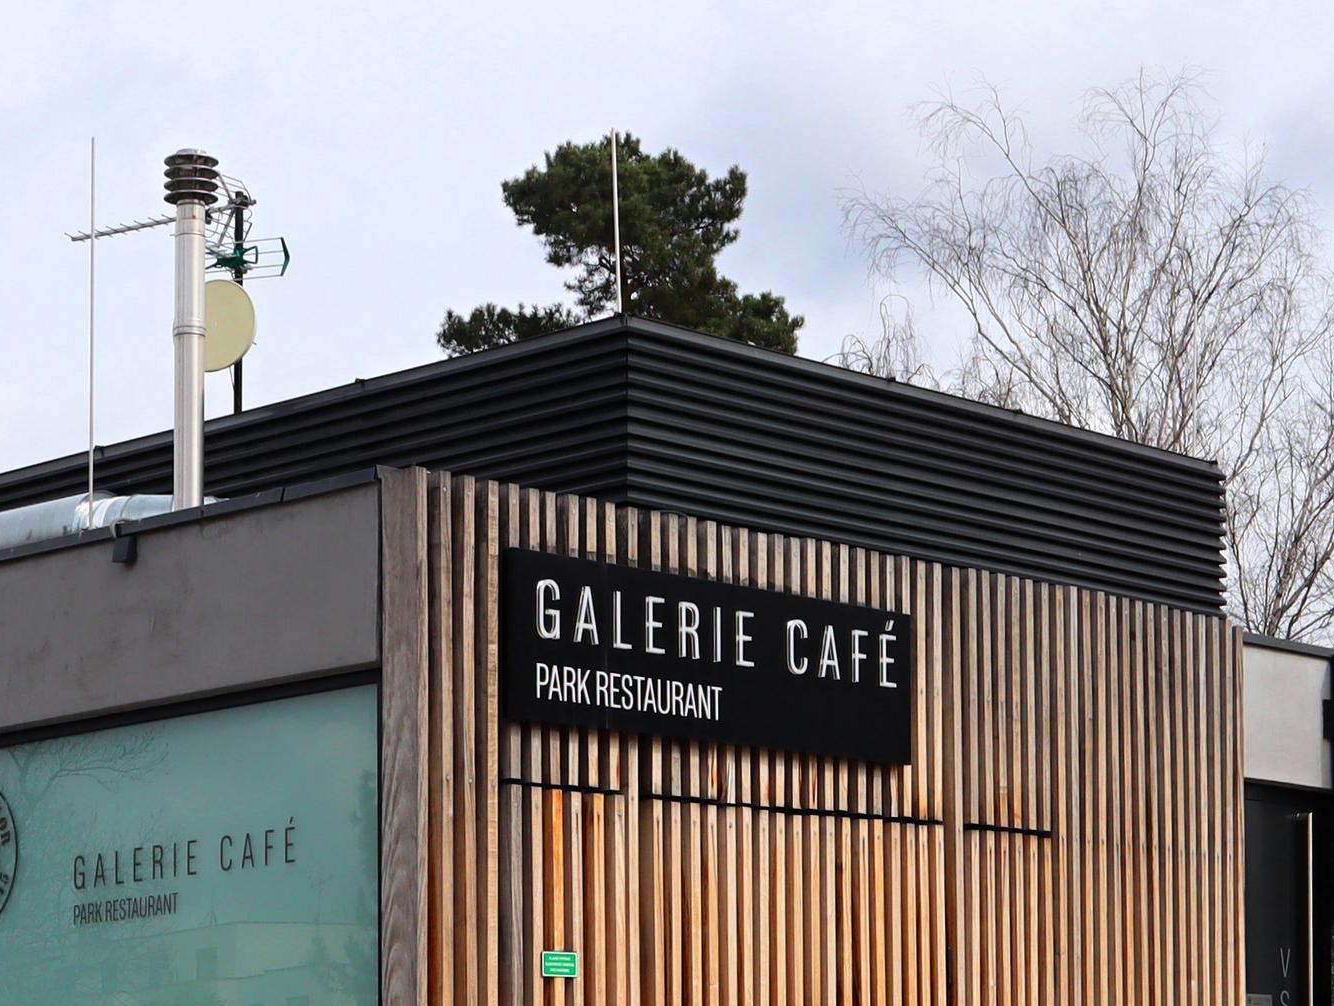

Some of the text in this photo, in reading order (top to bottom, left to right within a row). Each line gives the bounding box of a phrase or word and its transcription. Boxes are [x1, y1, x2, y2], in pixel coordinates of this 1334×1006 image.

[535, 578, 897, 688] GALERIE CAFÉ
[535, 662, 723, 722] PARK RESTAURANT
[73, 815, 298, 891] GALERIE CAFÉ
[72, 891, 179, 926] PARK RESTAURANT
